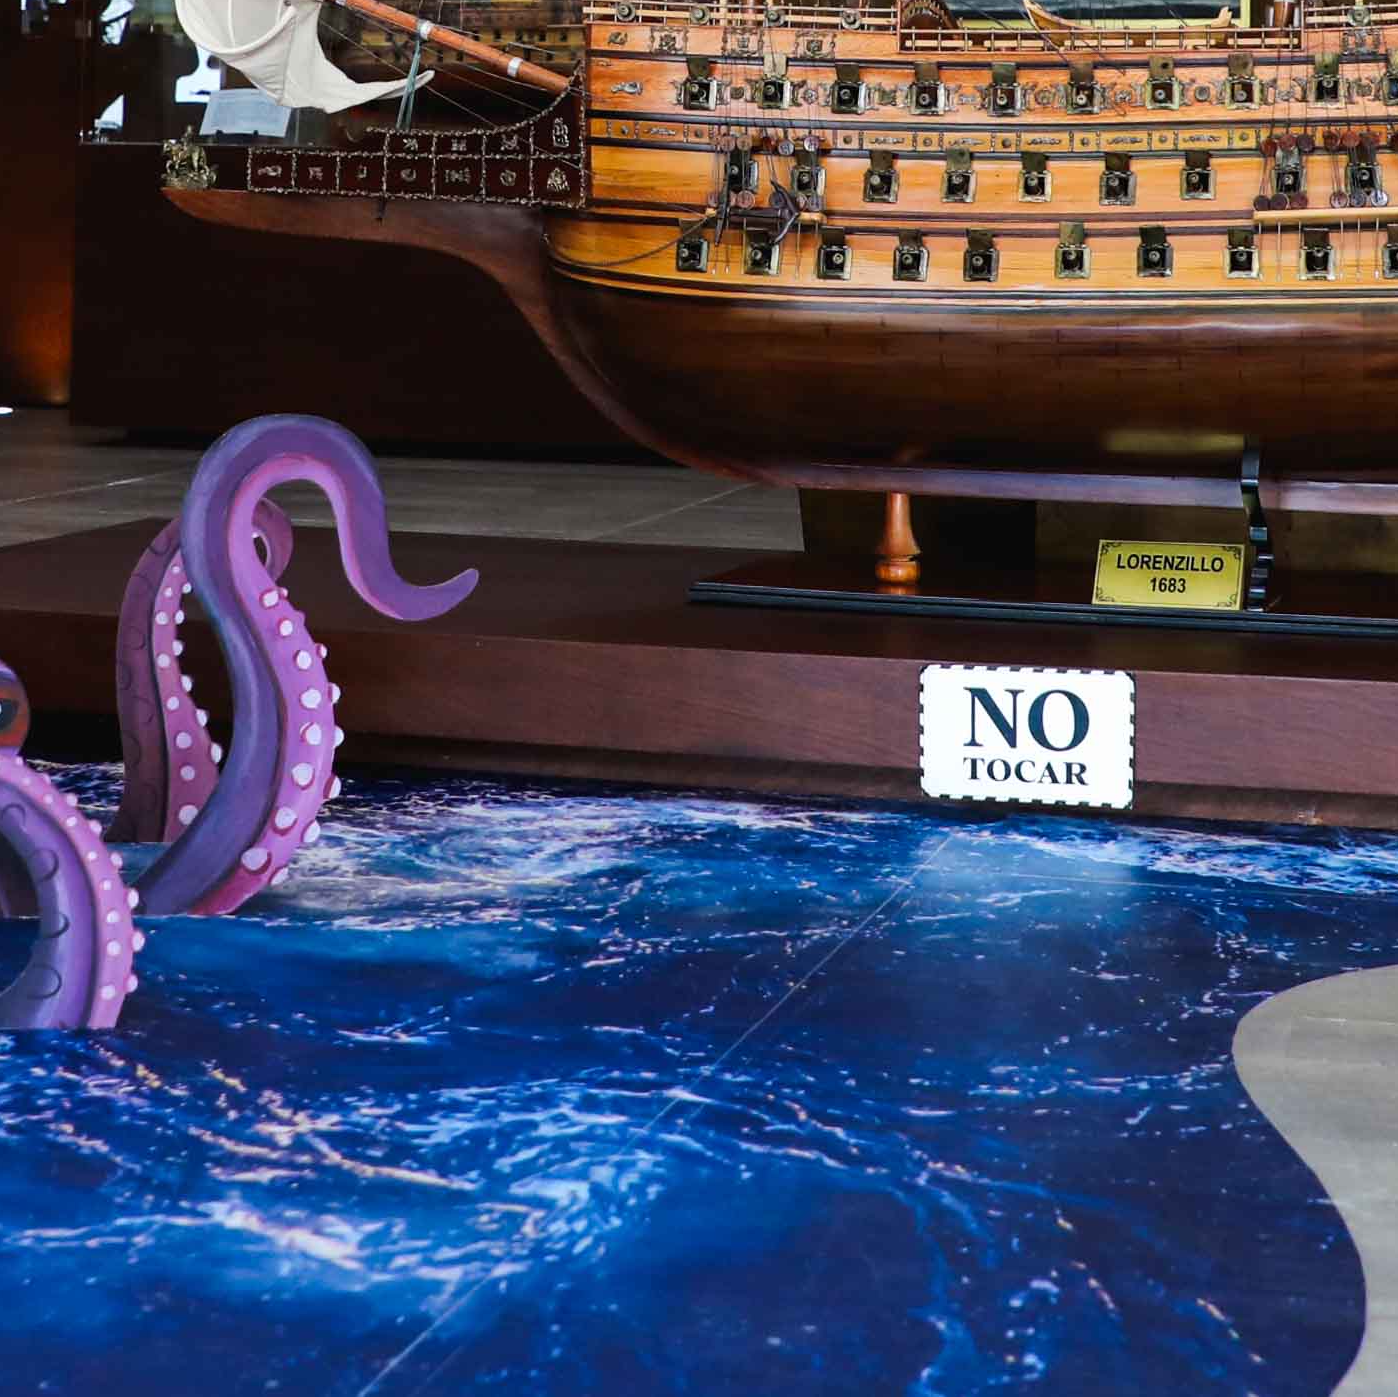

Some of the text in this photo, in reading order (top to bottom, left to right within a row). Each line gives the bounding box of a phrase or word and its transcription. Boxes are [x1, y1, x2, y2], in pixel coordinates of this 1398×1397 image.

[1116, 553, 1224, 572] LORENZILLO
[1149, 577, 1186, 593] 1683
[963, 686, 1090, 752] NO
[963, 757, 1089, 786] TOCAR
